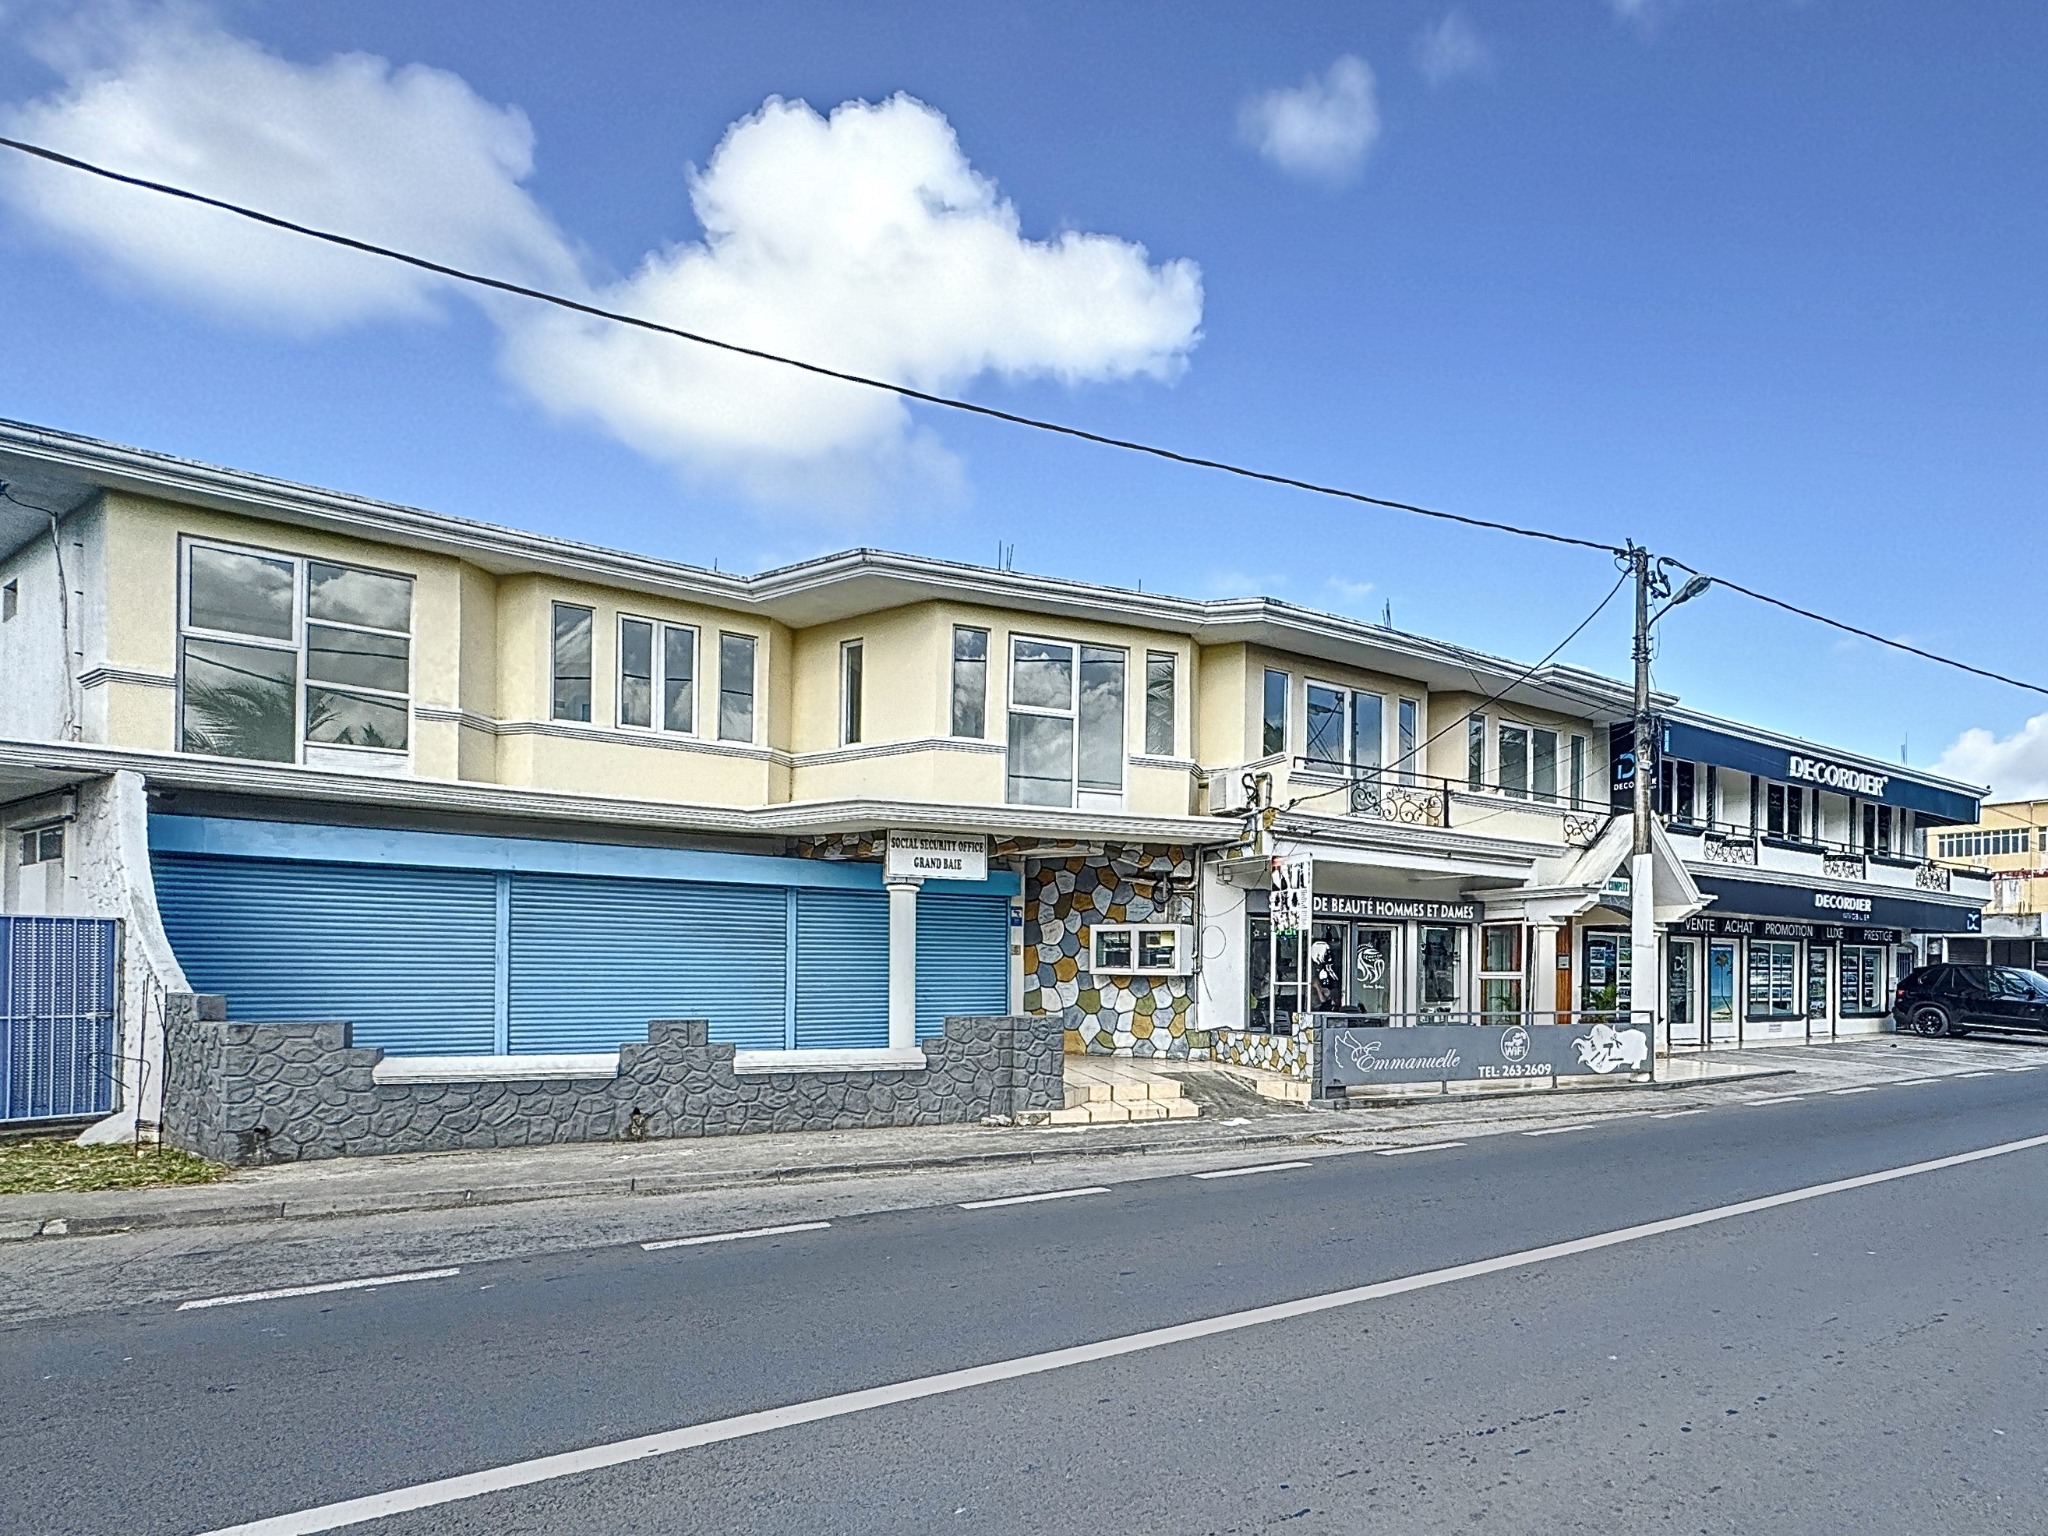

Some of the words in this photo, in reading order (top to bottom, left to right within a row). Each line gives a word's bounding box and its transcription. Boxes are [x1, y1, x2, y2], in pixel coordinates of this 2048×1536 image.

[1789, 755, 1884, 797] DECORDIER
[891, 837, 919, 849] SOCIAL
[919, 838, 957, 852] SECURITY
[958, 840, 984, 853] OFFICE
[913, 857, 942, 870] GRAND
[943, 858, 962, 870] BAIE
[1313, 896, 1328, 911] DE
[1331, 898, 1373, 915] BEAUTÉ
[1376, 901, 1424, 917] HOMMES
[1426, 904, 1439, 918] ET
[1440, 904, 1474, 919] DAMES
[1814, 893, 1872, 912] DECORDIER
[1685, 917, 1715, 932] VENTE
[1724, 920, 1754, 934] ACHAT
[1764, 923, 1814, 937] PROMOTION
[1826, 927, 1844, 939] LUXE
[1863, 929, 1893, 941] PRESTIGE
[1356, 1041, 1461, 1072] Emmanuelle
[1478, 1066, 1500, 1078] TEL:
[1502, 1063, 1552, 1077] 263-2609
